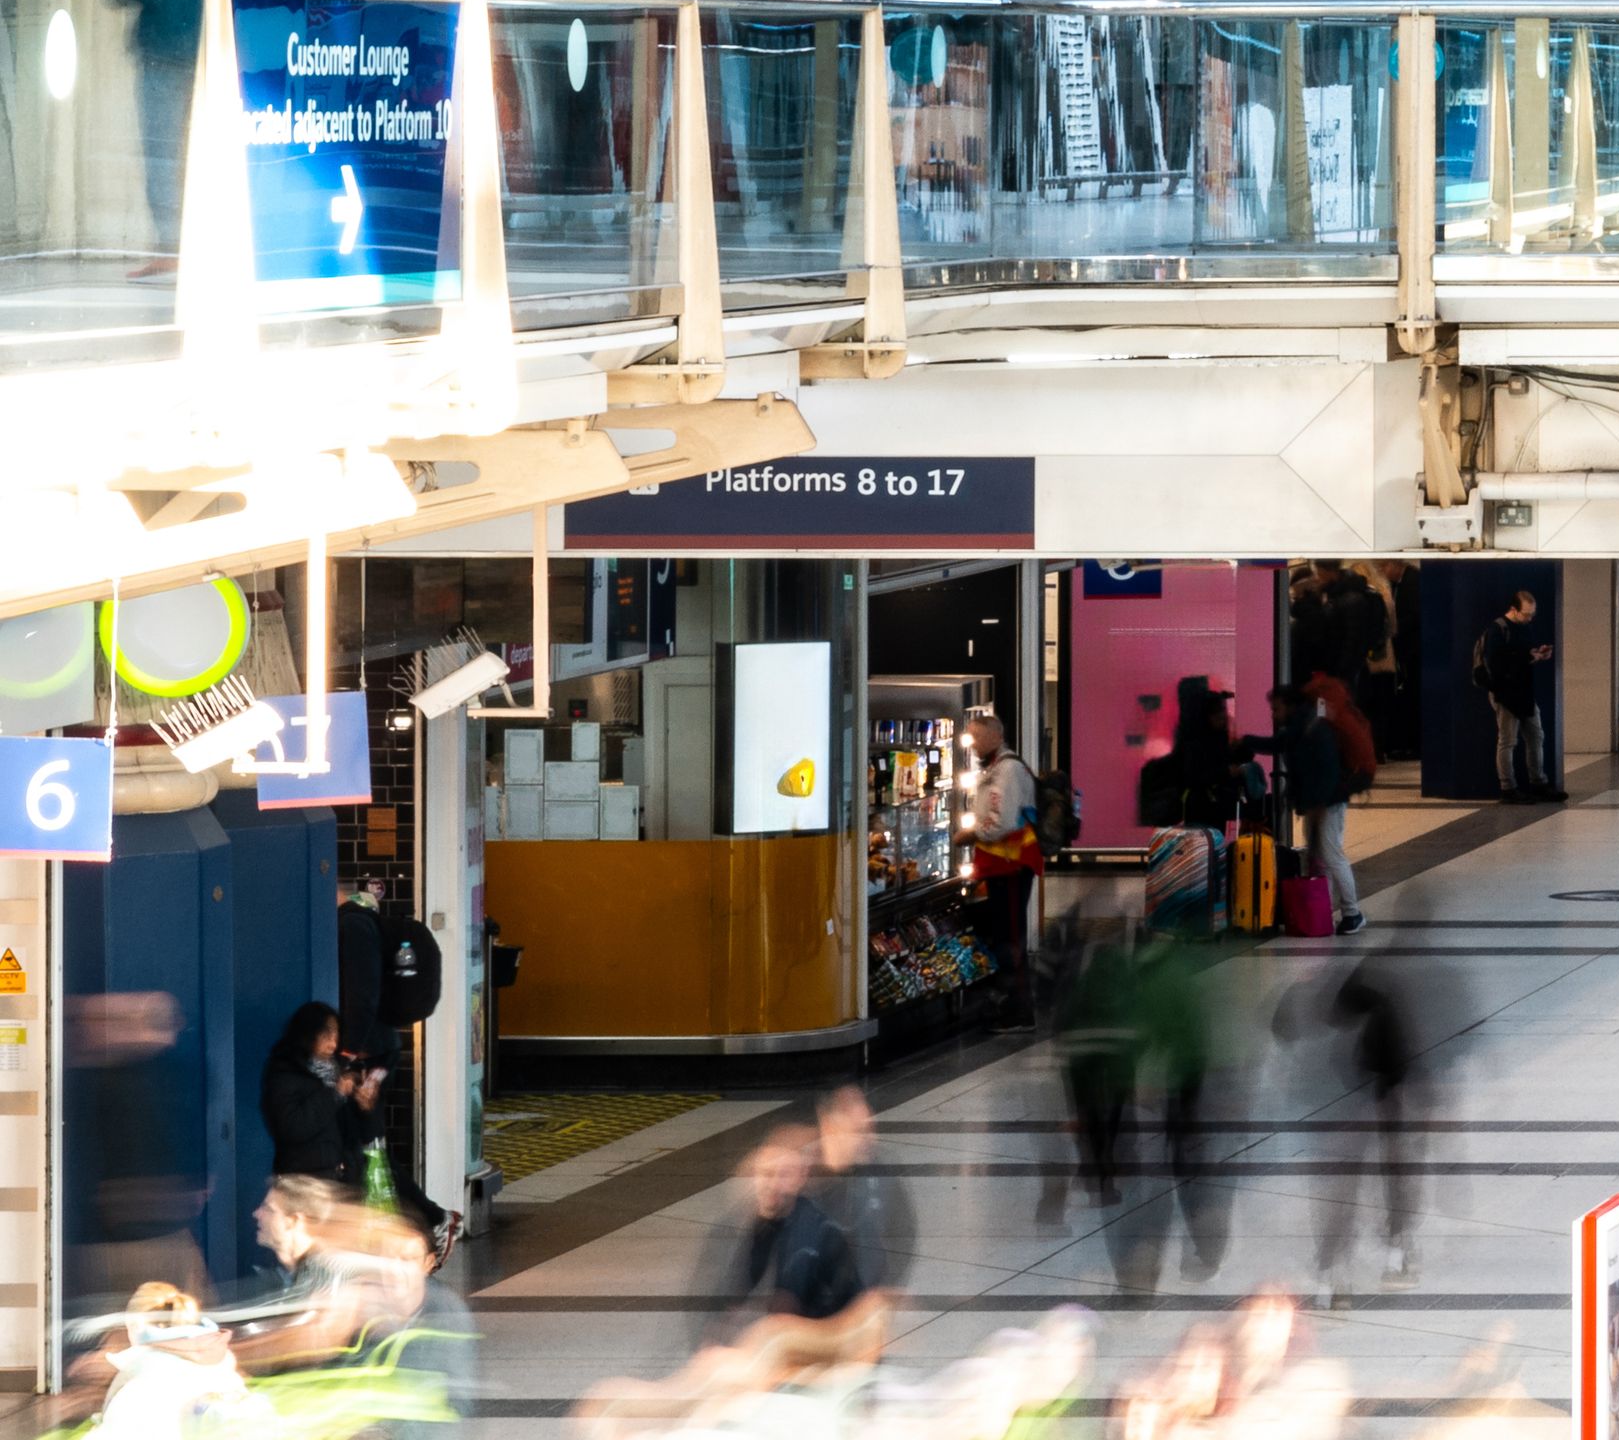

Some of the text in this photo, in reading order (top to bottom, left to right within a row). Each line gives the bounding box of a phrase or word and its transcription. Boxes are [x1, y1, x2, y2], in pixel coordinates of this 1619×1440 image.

[287, 32, 409, 86] Customer Lounge
[293, 99, 354, 154] adjacent
[357, 107, 371, 142] to
[375, 99, 431, 141] Platform
[435, 100, 452, 140] 10
[705, 466, 965, 496] Platforms 8 to 17
[25, 757, 79, 832] 6
